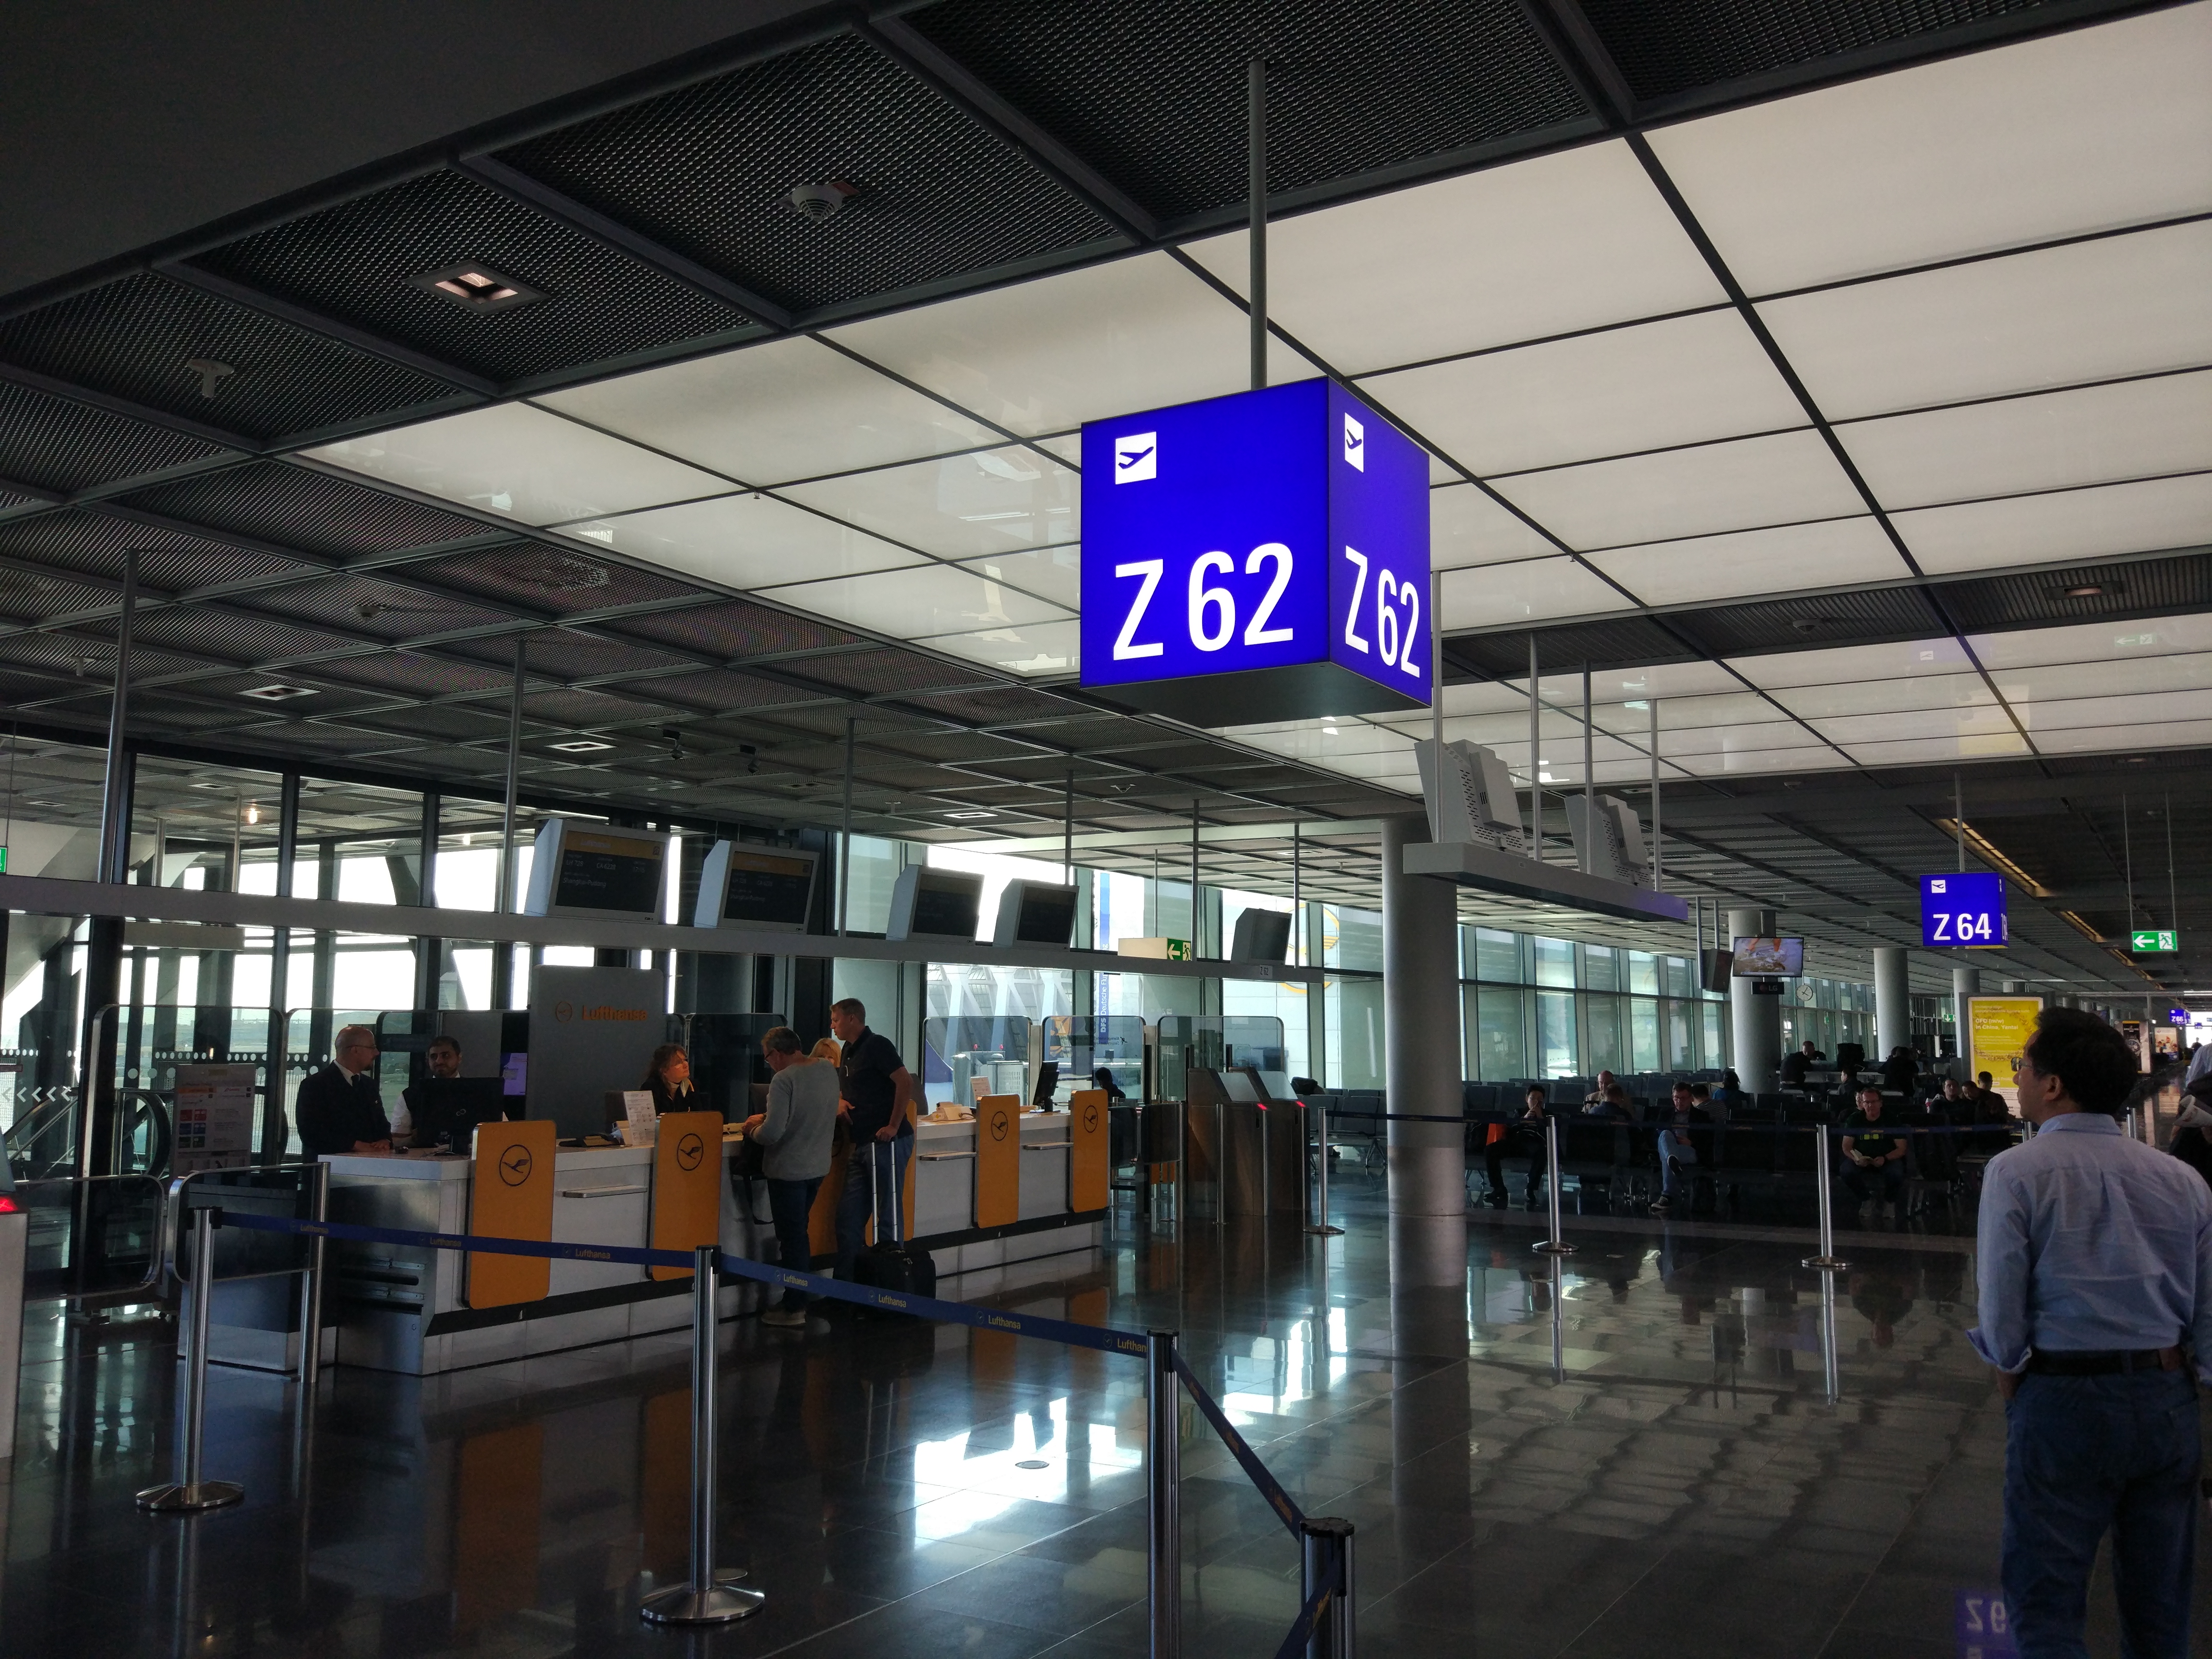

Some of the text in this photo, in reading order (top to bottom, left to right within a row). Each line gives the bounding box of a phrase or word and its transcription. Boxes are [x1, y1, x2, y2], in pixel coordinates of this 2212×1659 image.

[1113, 542, 1293, 661] Z 62
[1346, 545, 1420, 678] Z 62
[1933, 913, 1992, 940] Z 64
[1260, 966, 1269, 975] Z 62
[582, 1005, 647, 1021] Lufthansa
[430, 1237, 461, 1247] Lufthansa
[575, 1249, 611, 1259] Lufthansa
[783, 1274, 808, 1286] Lufthansa
[878, 1294, 907, 1308] Lufthansa
[988, 1315, 1021, 1330] Lufthansa
[1117, 1338, 1147, 1352] Lufthan
